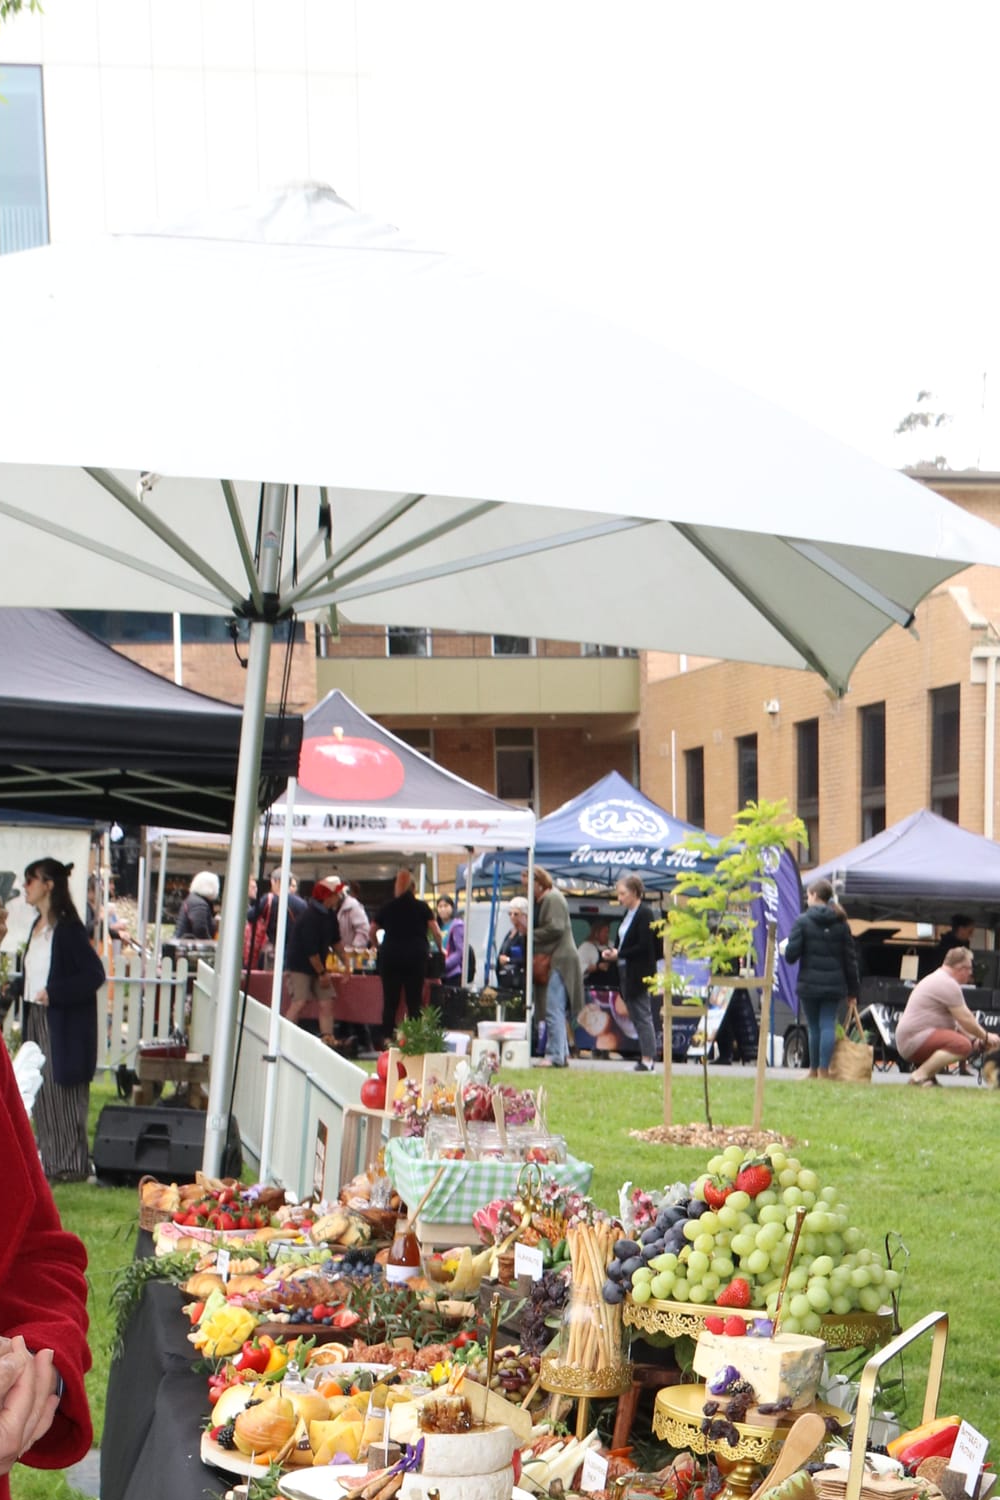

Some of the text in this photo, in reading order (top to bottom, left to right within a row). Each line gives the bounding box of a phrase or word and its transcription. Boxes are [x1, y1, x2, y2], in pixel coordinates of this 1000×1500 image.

[323, 813, 387, 829] Apples
[569, 844, 701, 868] Arancini 4 All
